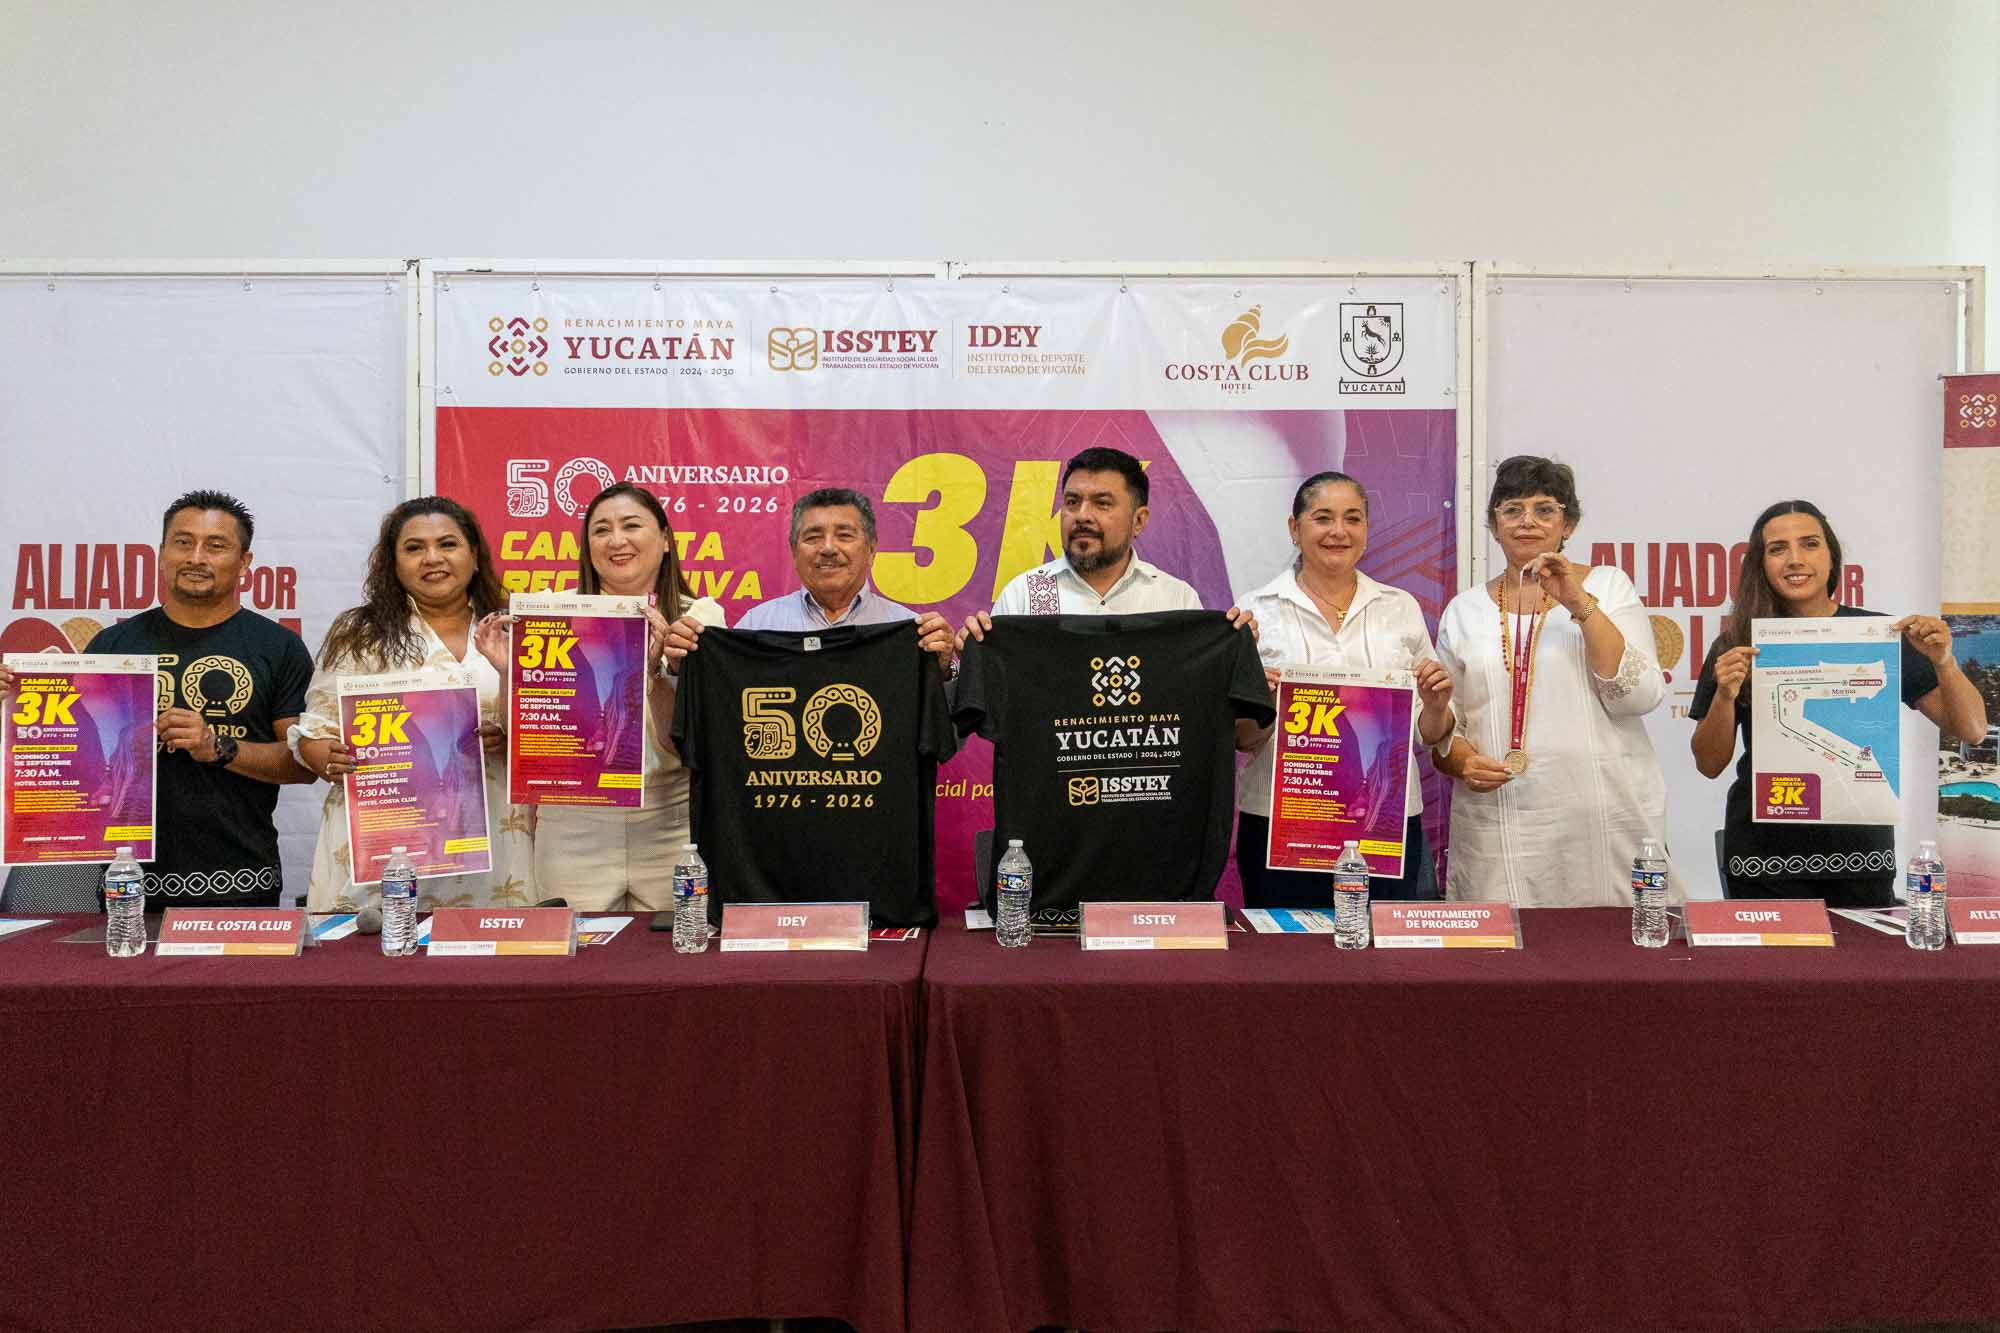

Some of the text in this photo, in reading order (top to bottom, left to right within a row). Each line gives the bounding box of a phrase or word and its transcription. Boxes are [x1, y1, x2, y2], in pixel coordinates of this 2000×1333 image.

[564, 319, 733, 329] RENACIMIENTO MAYA
[822, 330, 938, 353] ISSTEY
[967, 325, 1042, 347] IDEY
[563, 333, 735, 360] YUCATÁN
[968, 354, 1085, 363] INSTITUTO DEL DEPORTE
[564, 367, 612, 375] GOBIERNO
[614, 367, 632, 375] DEL
[633, 367, 669, 375] ESTADO
[968, 364, 1086, 375] DEL ESTADO DE YUCATÁN
[1165, 364, 1310, 381] COSTA CLUB
[1221, 383, 1253, 391] HOTEL
[1343, 384, 1402, 392] YUCATAN
[623, 465, 789, 485] ANIVERSARIO
[659, 496, 687, 513] 76
[716, 496, 778, 513] 2026
[501, 530, 725, 560] CAMTA
[12, 544, 168, 609] ALIAD
[502, 570, 762, 600] RECIVA
[518, 635, 580, 669] 3K
[522, 669, 545, 683] 50
[12, 692, 82, 725] 3K
[520, 712, 562, 721] 7:30 A.M.
[742, 684, 882, 761] 50
[1054, 714, 1181, 727] RENACIMIENTO MAYA
[1284, 702, 1347, 737] 3K
[351, 712, 413, 747] 3K
[1055, 725, 1181, 750] YUCATÁN
[1287, 735, 1309, 748] 50
[1056, 754, 1092, 762] GOBIERNO
[15, 769, 62, 777] 7:30 A.M.
[745, 770, 882, 786] ANIVERSARIO
[1100, 775, 1171, 793] ISSTEY
[1283, 776, 1324, 787] 7:30 A.M.
[357, 787, 400, 798] 7:30 A.M.
[1768, 786, 1806, 805] 3K
[754, 794, 801, 809] 1976
[826, 794, 874, 808] 2026
[1133, 914, 1177, 925] ISSTEY
[1392, 909, 1491, 919] H. AYUNTAMIENTO
[1735, 911, 1782, 923] CEJUPE
[1969, 910, 2000, 920] ATLET
[172, 920, 293, 932] HOTEL COSTA CLUB
[479, 918, 525, 929] ISSTEY
[777, 916, 808, 927] IDEY
[1406, 919, 1479, 929] DE PROGRESO
